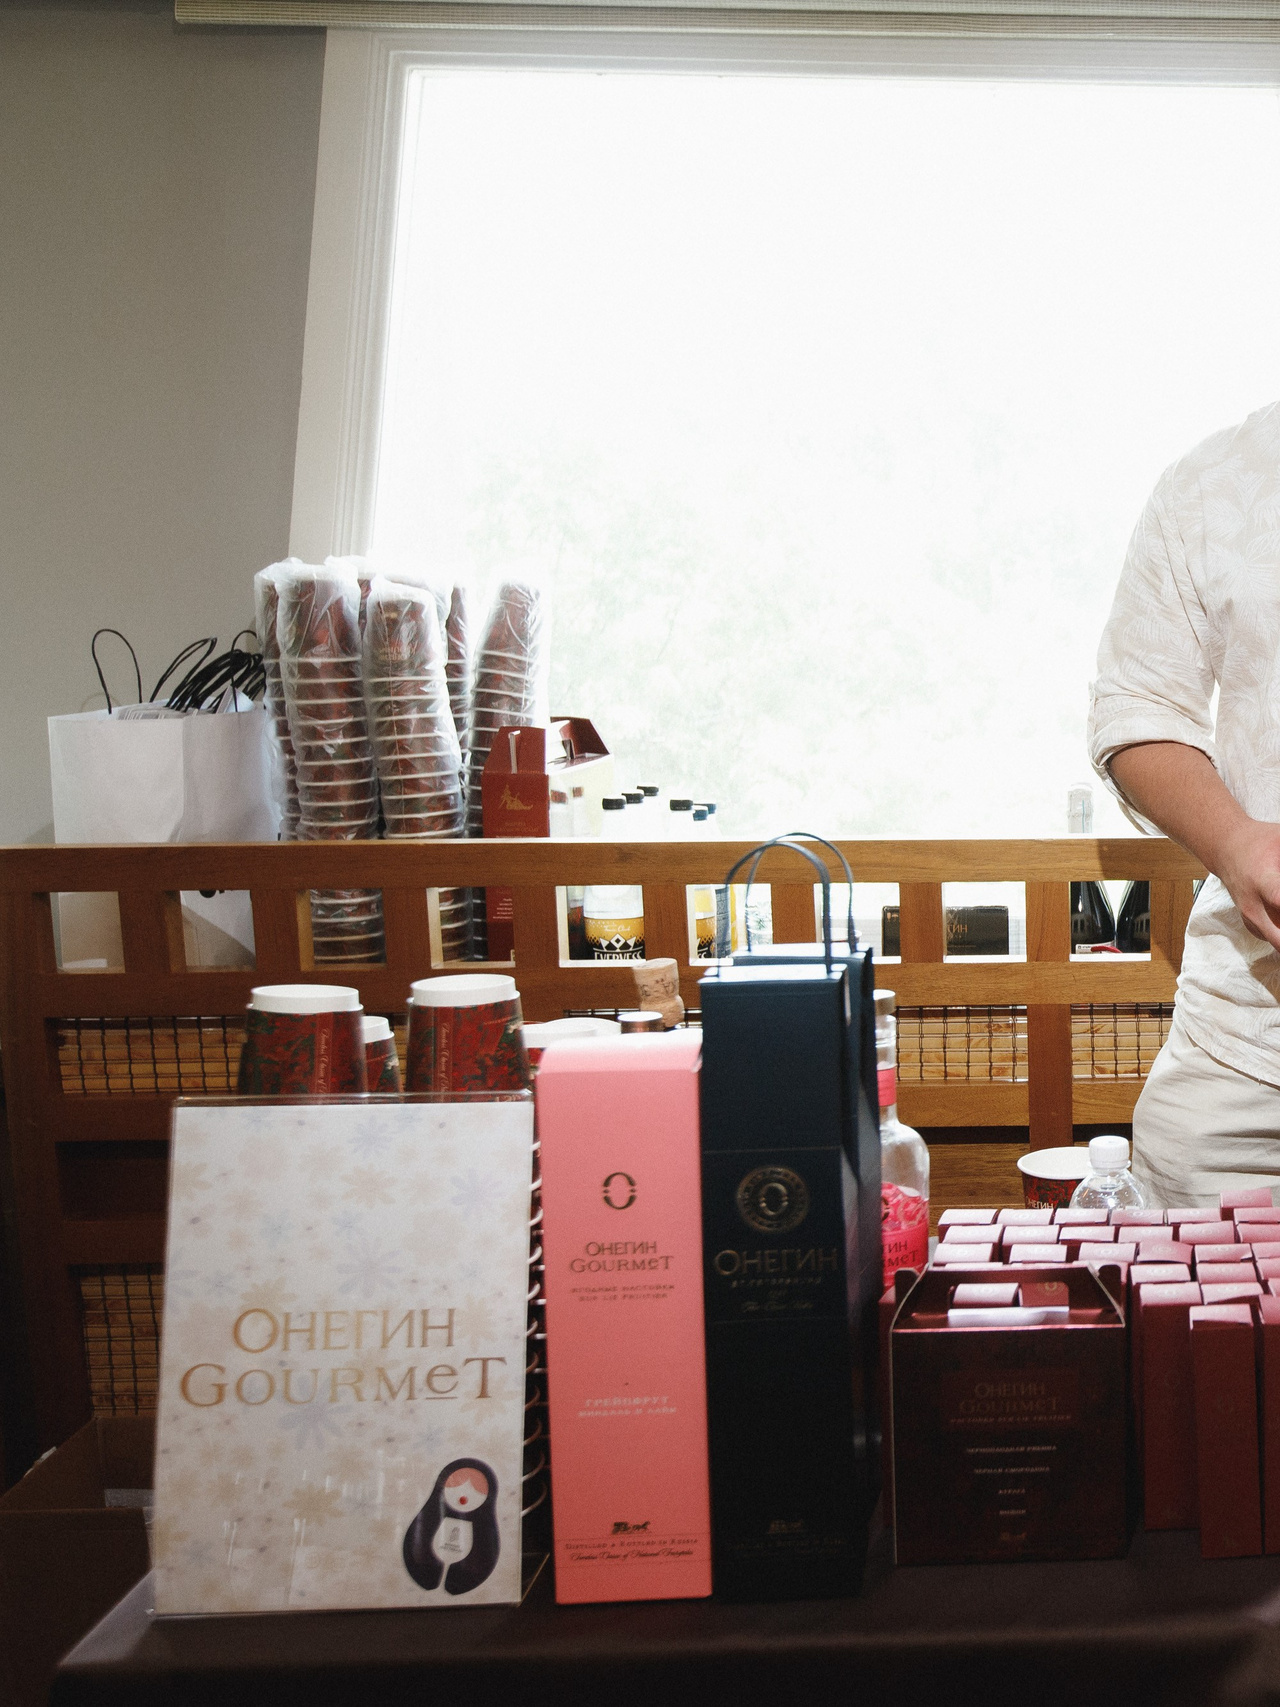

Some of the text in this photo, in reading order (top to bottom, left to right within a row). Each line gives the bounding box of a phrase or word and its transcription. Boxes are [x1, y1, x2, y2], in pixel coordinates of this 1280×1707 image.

[585, 1241, 658, 1256] ОНЕГИН
[713, 1248, 838, 1276] ОНЕГИН
[232, 1307, 457, 1354] ОНЕГИН
[974, 1382, 1046, 1398] ОНЕГИН
